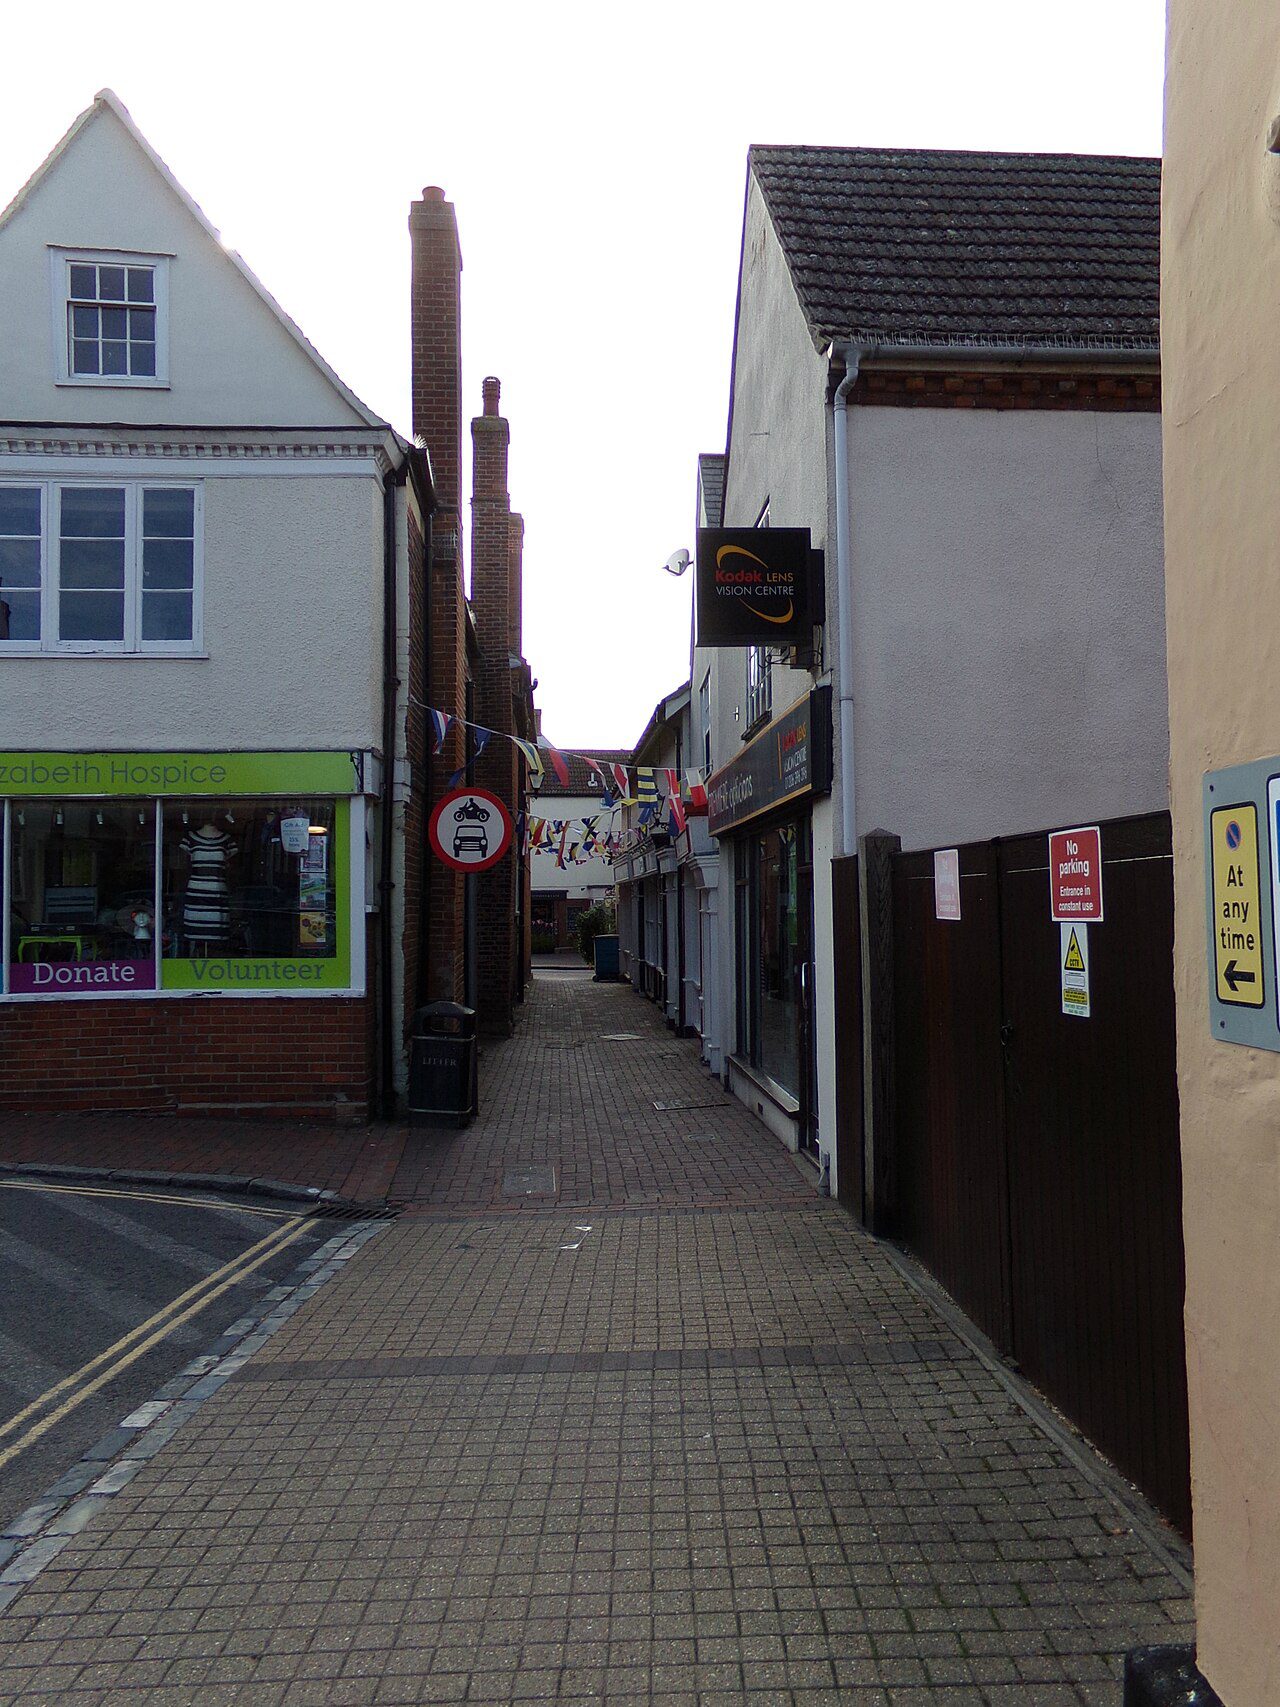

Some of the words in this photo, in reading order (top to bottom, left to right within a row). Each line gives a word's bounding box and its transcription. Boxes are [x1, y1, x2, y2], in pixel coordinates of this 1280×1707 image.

[715, 569, 762, 583] Kodak
[766, 572, 794, 583] LENS
[715, 585, 752, 596] VISION
[754, 585, 794, 596] CENTRE
[111, 759, 227, 788] Hospice
[1066, 839, 1079, 856] No
[1059, 858, 1090, 878] parking
[1227, 864, 1244, 887] At
[1059, 886, 1084, 897] Entrance
[1084, 884, 1091, 896] in
[1058, 901, 1081, 912] constant
[1081, 901, 1094, 912] use
[1222, 901, 1250, 924] any
[1220, 926, 1255, 951] time
[32, 962, 136, 985] Donate
[189, 960, 326, 981] Volunteer
[422, 1056, 457, 1066] LITTER
